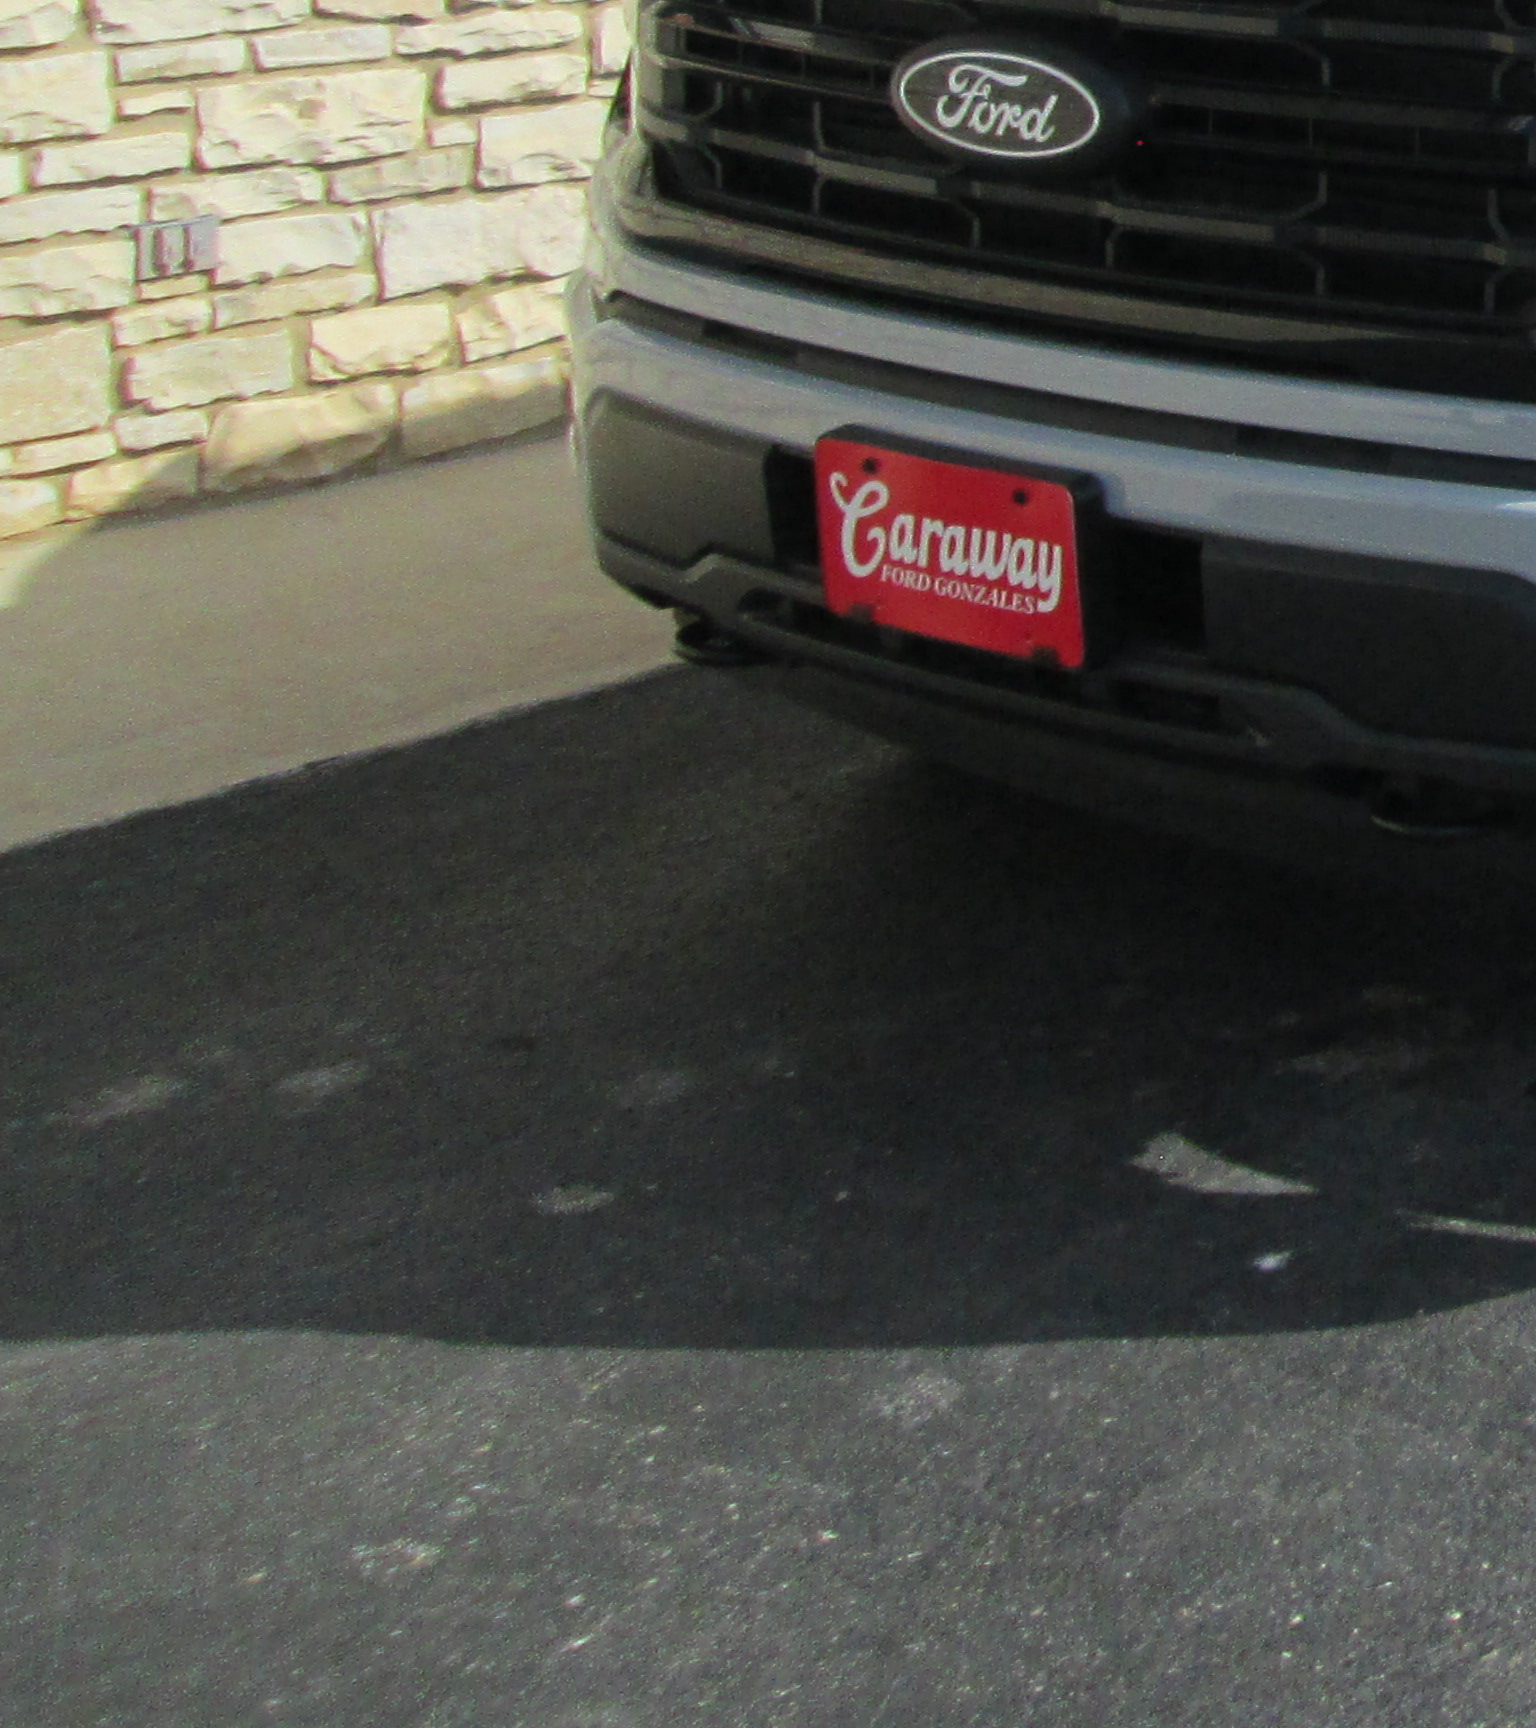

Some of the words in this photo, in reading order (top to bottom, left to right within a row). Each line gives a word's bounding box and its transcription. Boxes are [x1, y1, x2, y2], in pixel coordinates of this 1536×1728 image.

[936, 64, 1059, 143] Ford
[829, 471, 1063, 613] Caraway
[879, 563, 932, 592] FORD
[934, 576, 1037, 615] GONZALES
